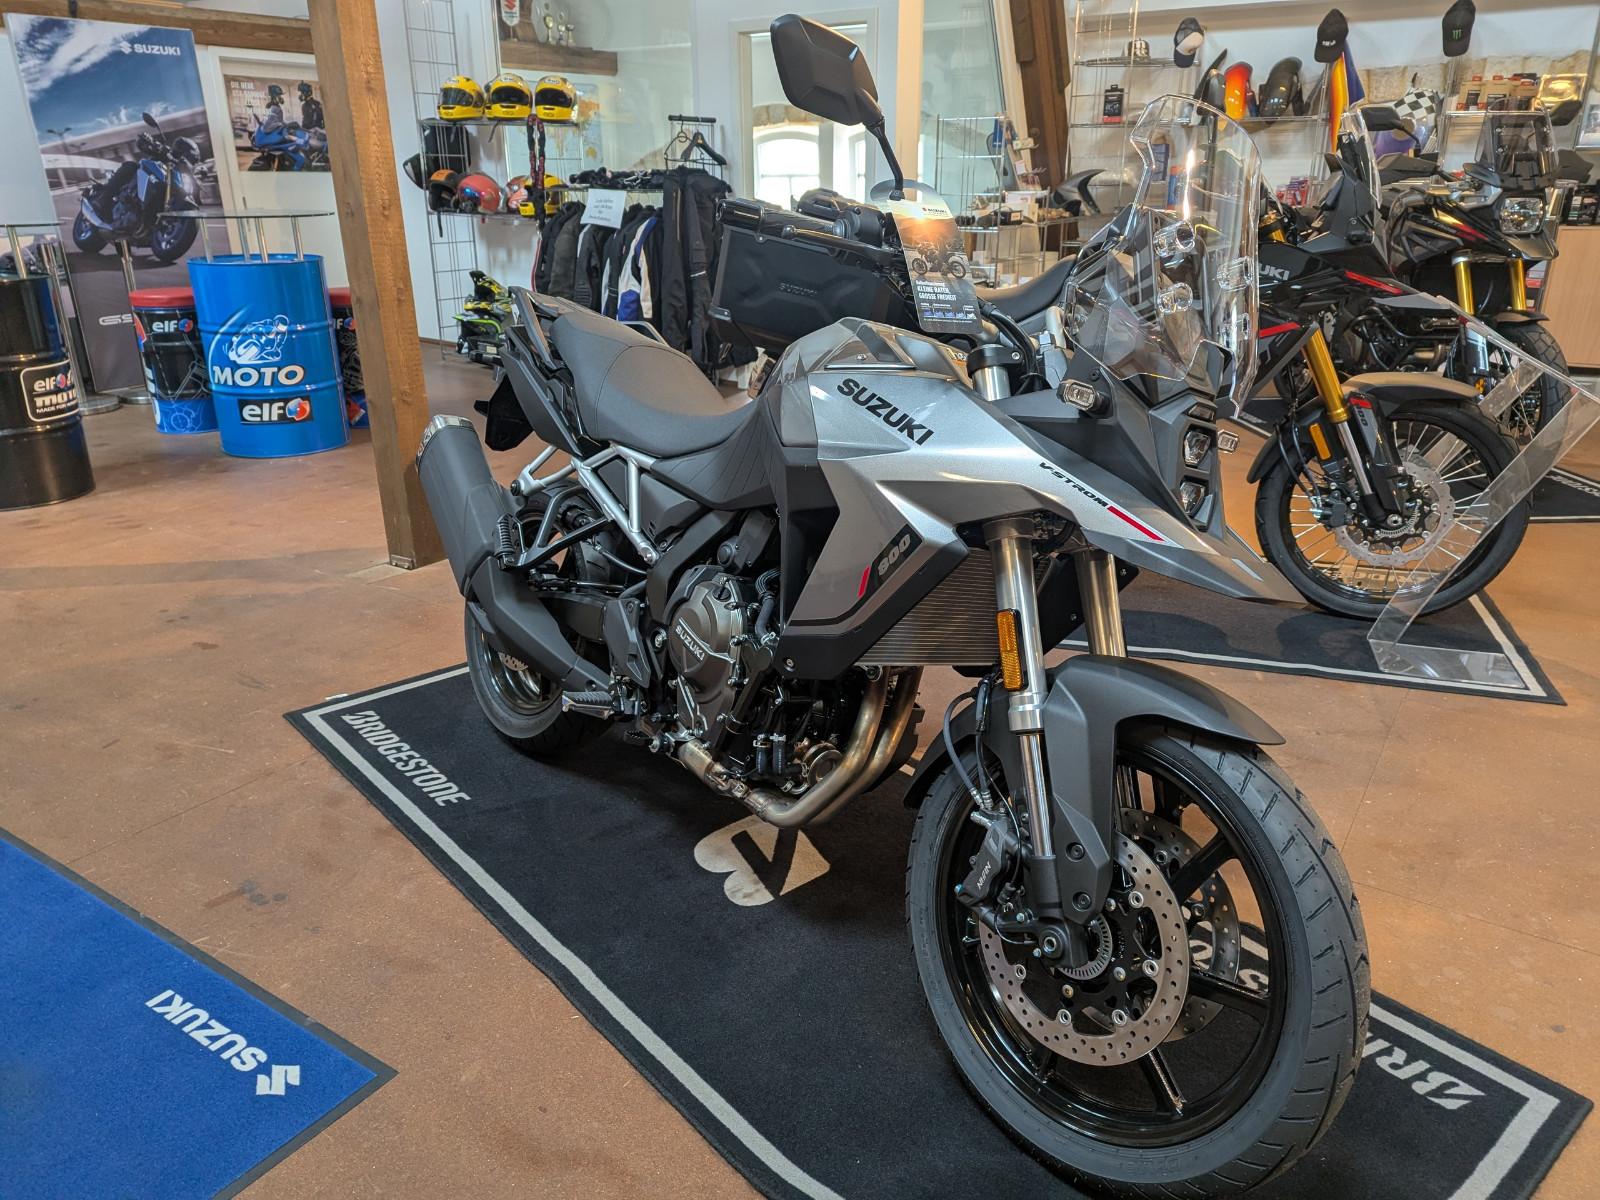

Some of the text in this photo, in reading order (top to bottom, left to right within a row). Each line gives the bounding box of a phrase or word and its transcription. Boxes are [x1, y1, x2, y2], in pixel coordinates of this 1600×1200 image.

[133, 44, 181, 56] SUZUKI
[152, 320, 178, 333] elf
[33, 375, 57, 392] elf
[213, 364, 305, 387] MOTO
[242, 401, 286, 422] elf
[836, 377, 935, 447] SUZUKI
[1039, 461, 1109, 508] V-STROM
[878, 533, 911, 576] 800
[675, 624, 705, 661] SUZUKI
[340, 710, 472, 807] BRIDGESTONE
[144, 989, 269, 1073] SUZUKI
